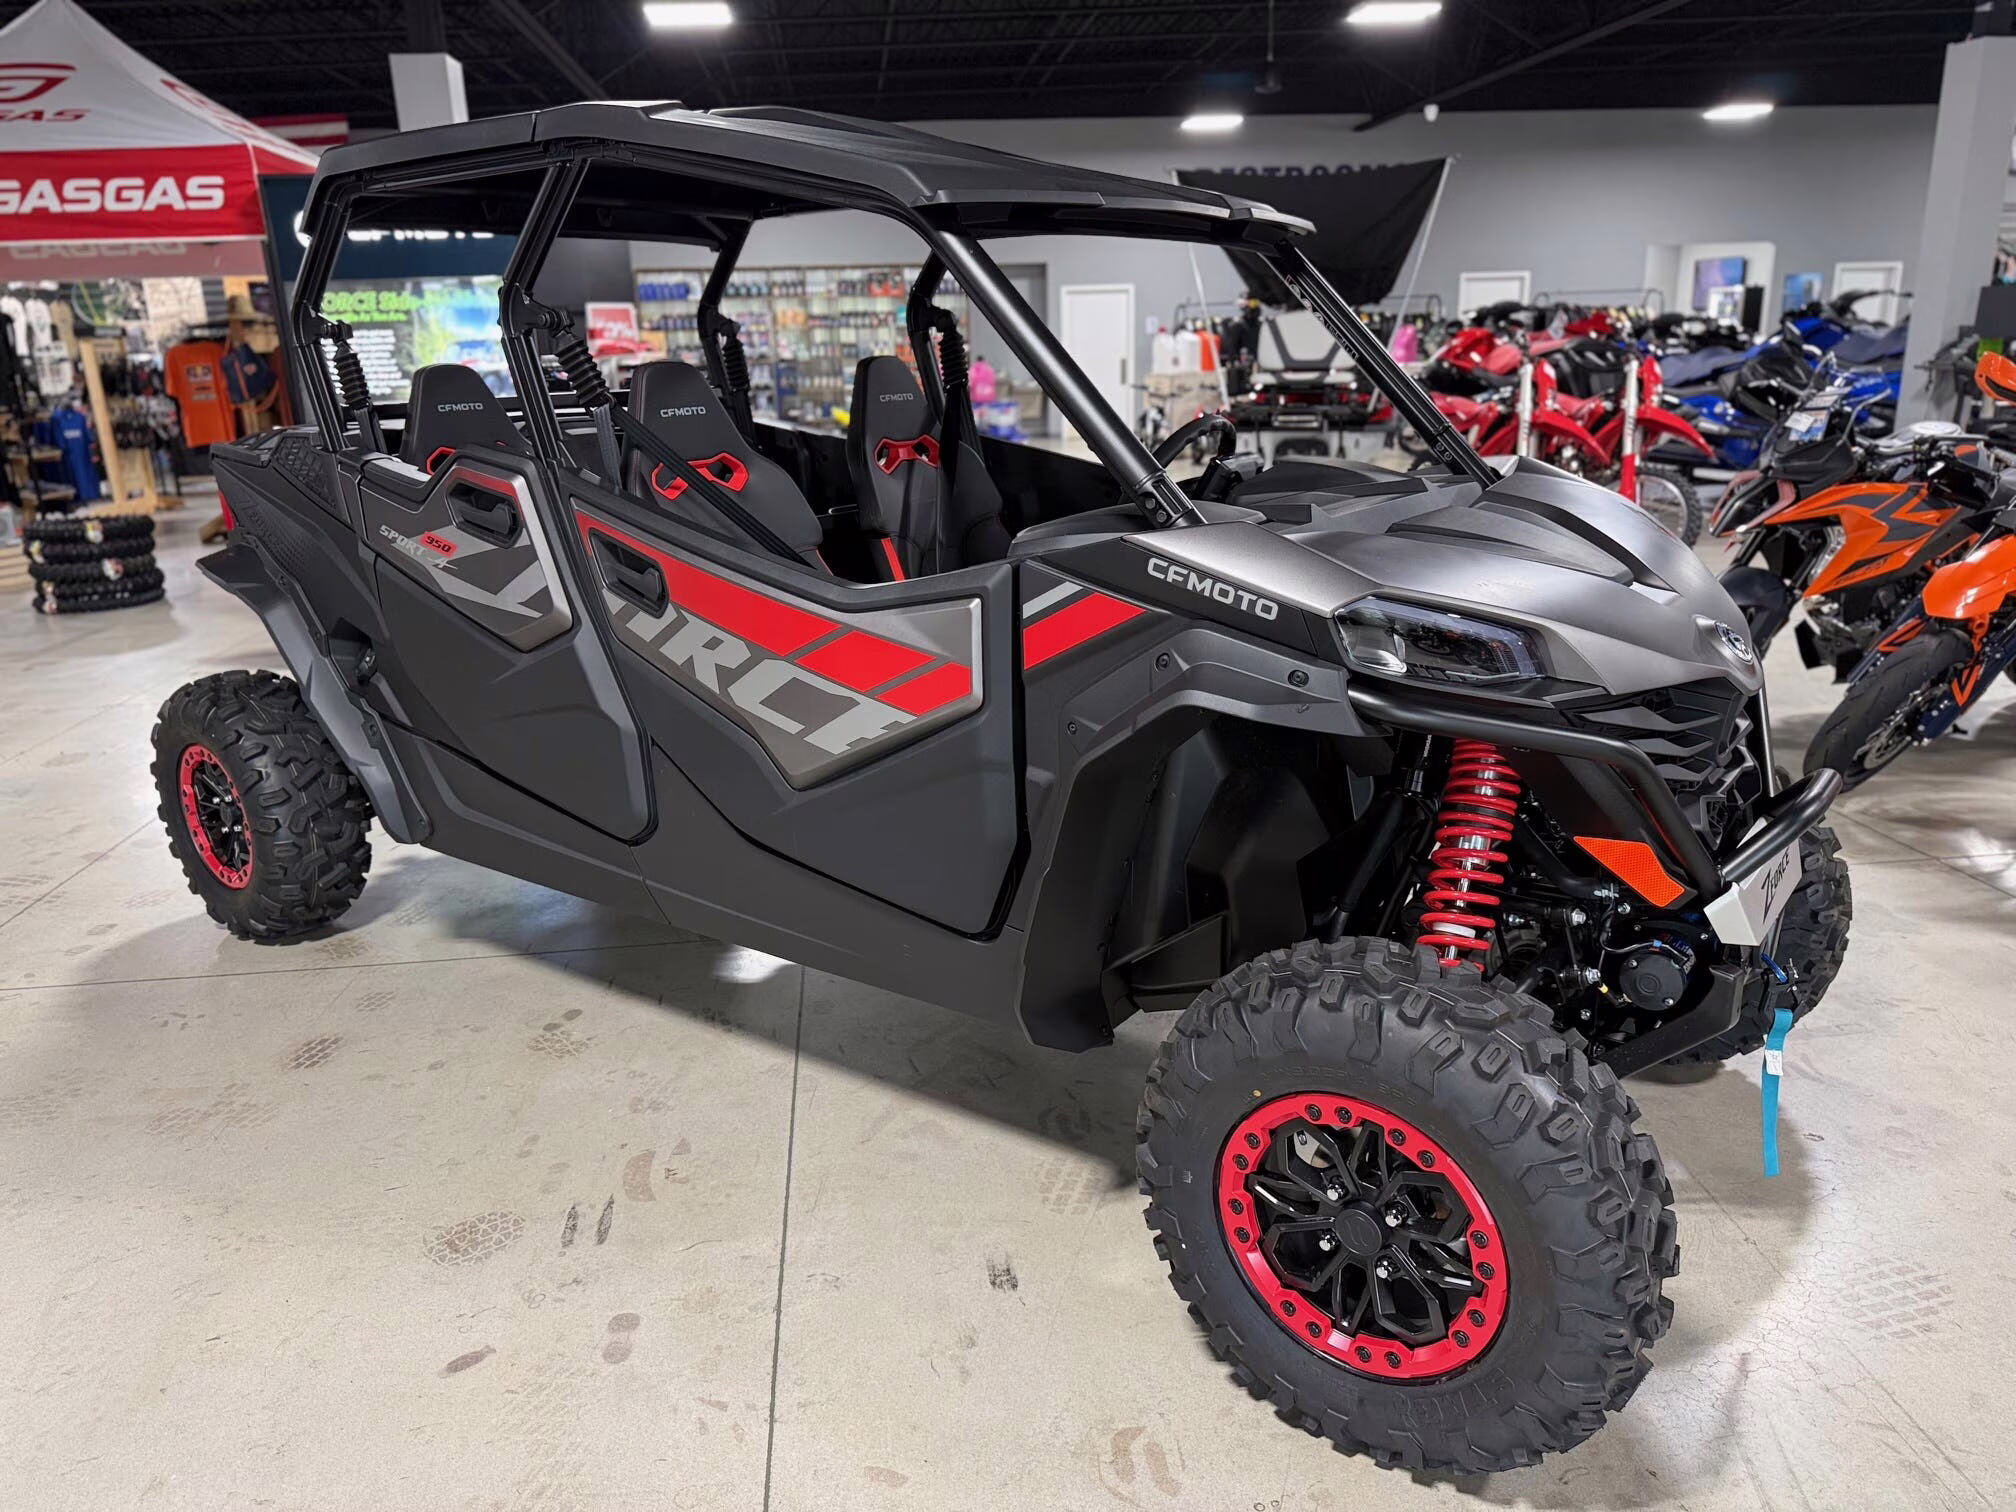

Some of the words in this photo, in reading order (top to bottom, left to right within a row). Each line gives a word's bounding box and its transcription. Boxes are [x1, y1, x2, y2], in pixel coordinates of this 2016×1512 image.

[879, 393, 914, 402] CFMOTO
[437, 402, 484, 412] CFMOTO
[660, 406, 706, 418] CFMOTO
[425, 536, 452, 553] 950
[1147, 557, 1279, 621] CFMOTO
